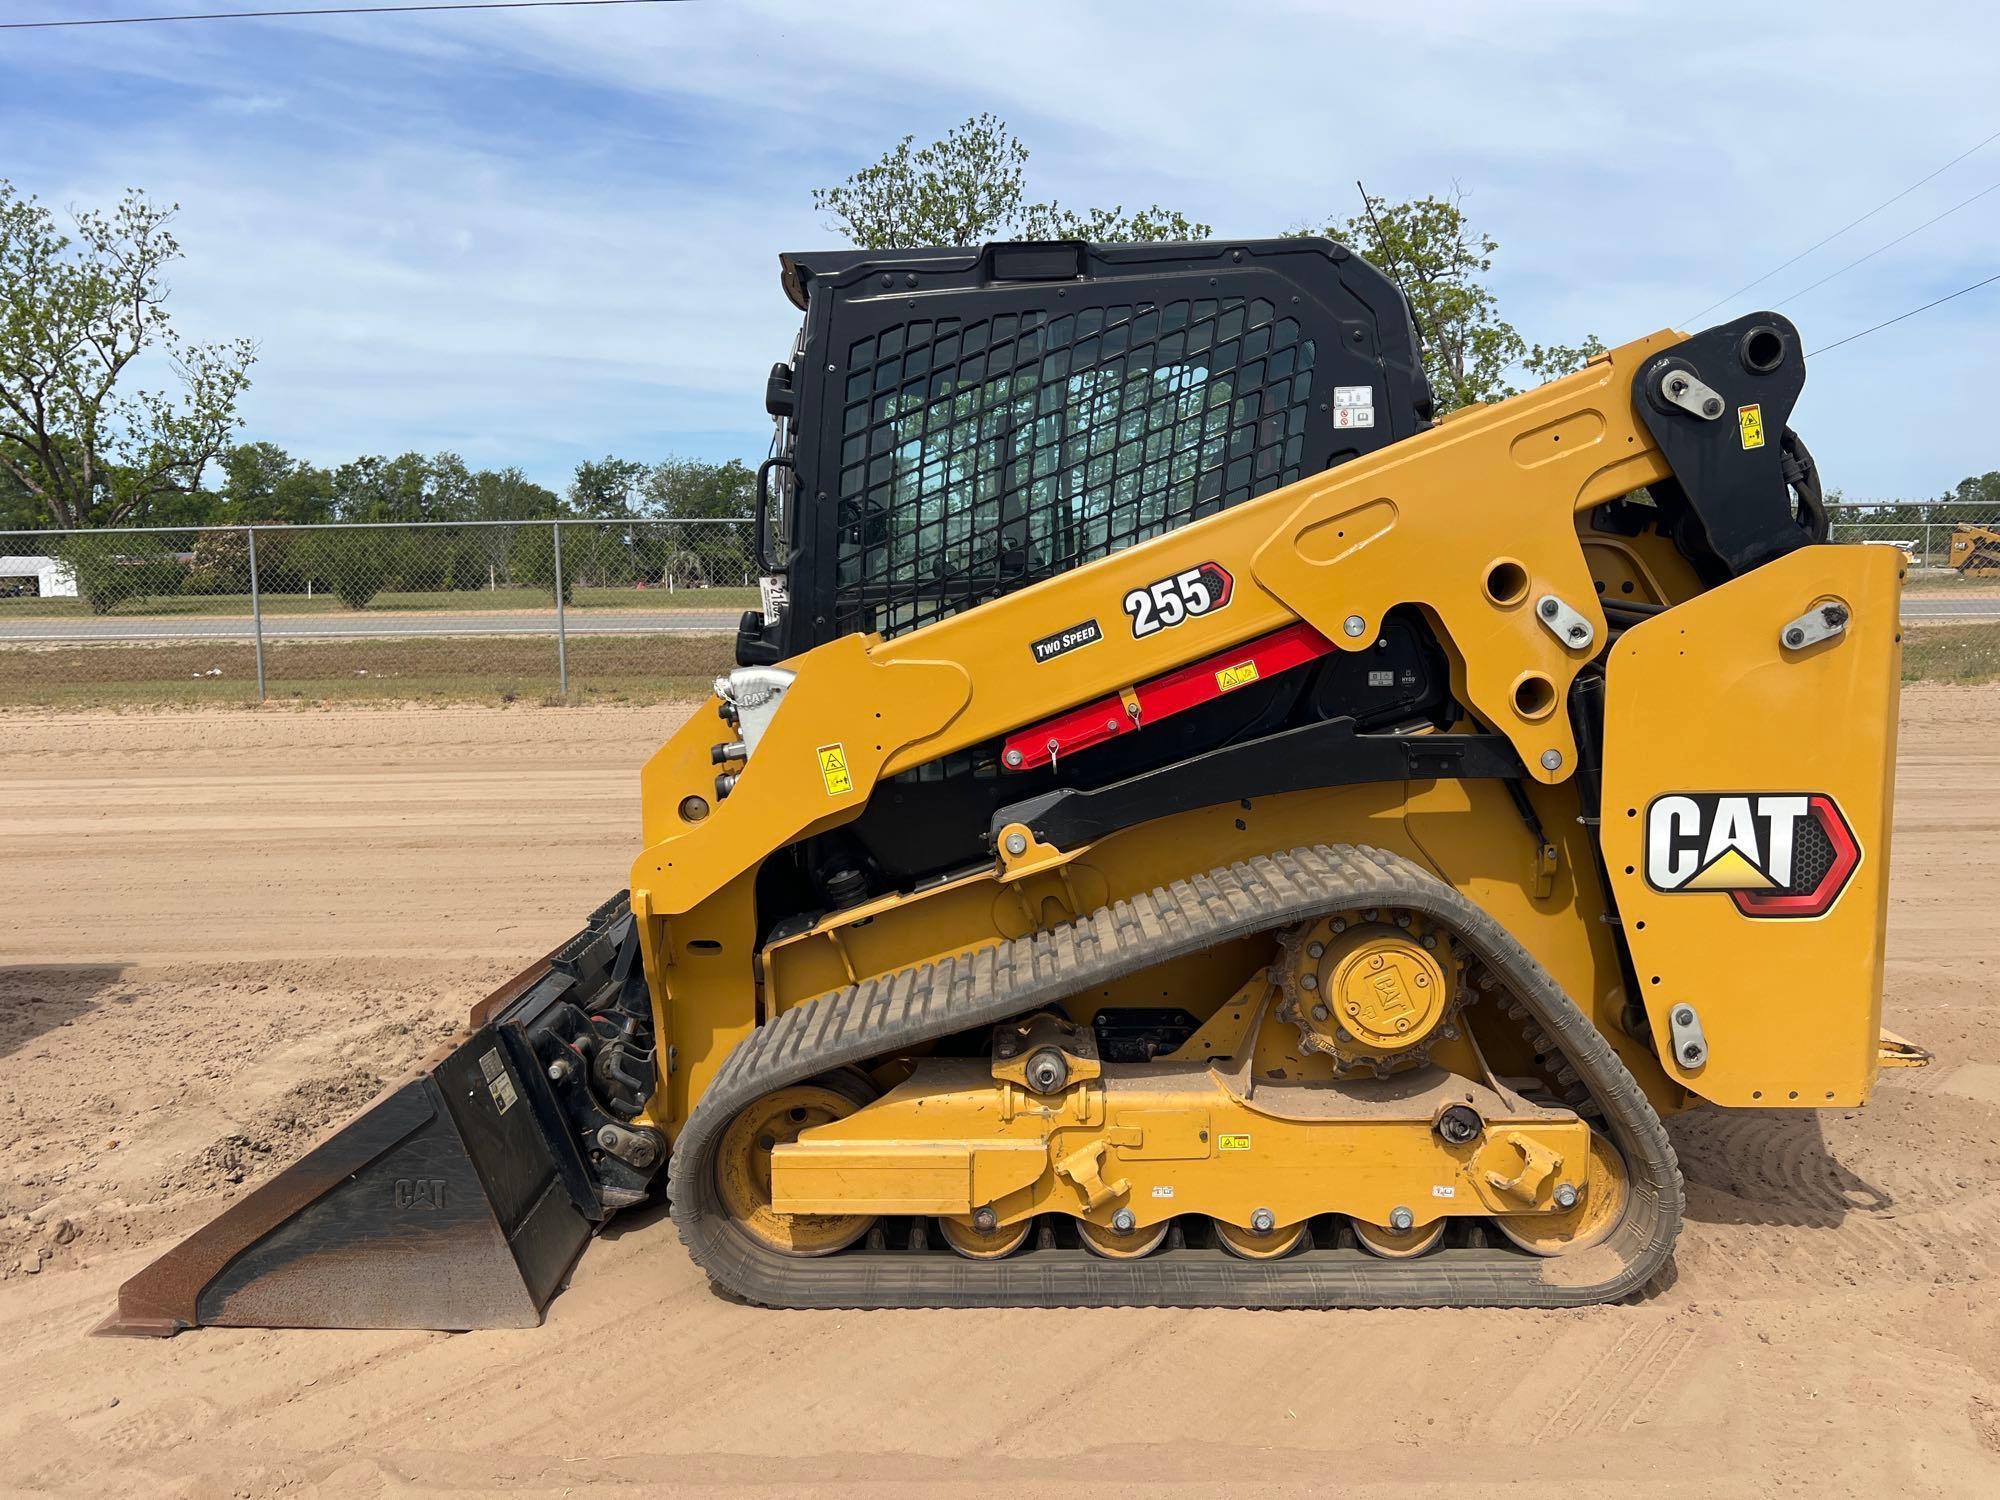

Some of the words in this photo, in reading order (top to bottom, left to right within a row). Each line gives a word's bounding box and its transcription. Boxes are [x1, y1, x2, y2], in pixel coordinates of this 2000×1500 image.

[1125, 569, 1212, 637] 255
[1037, 640, 1061, 657] TWO
[1062, 627, 1095, 648] SPEED
[1648, 796, 1809, 889] CAT
[1373, 973, 1406, 1012] CAT
[395, 1179, 448, 1210] CAT
